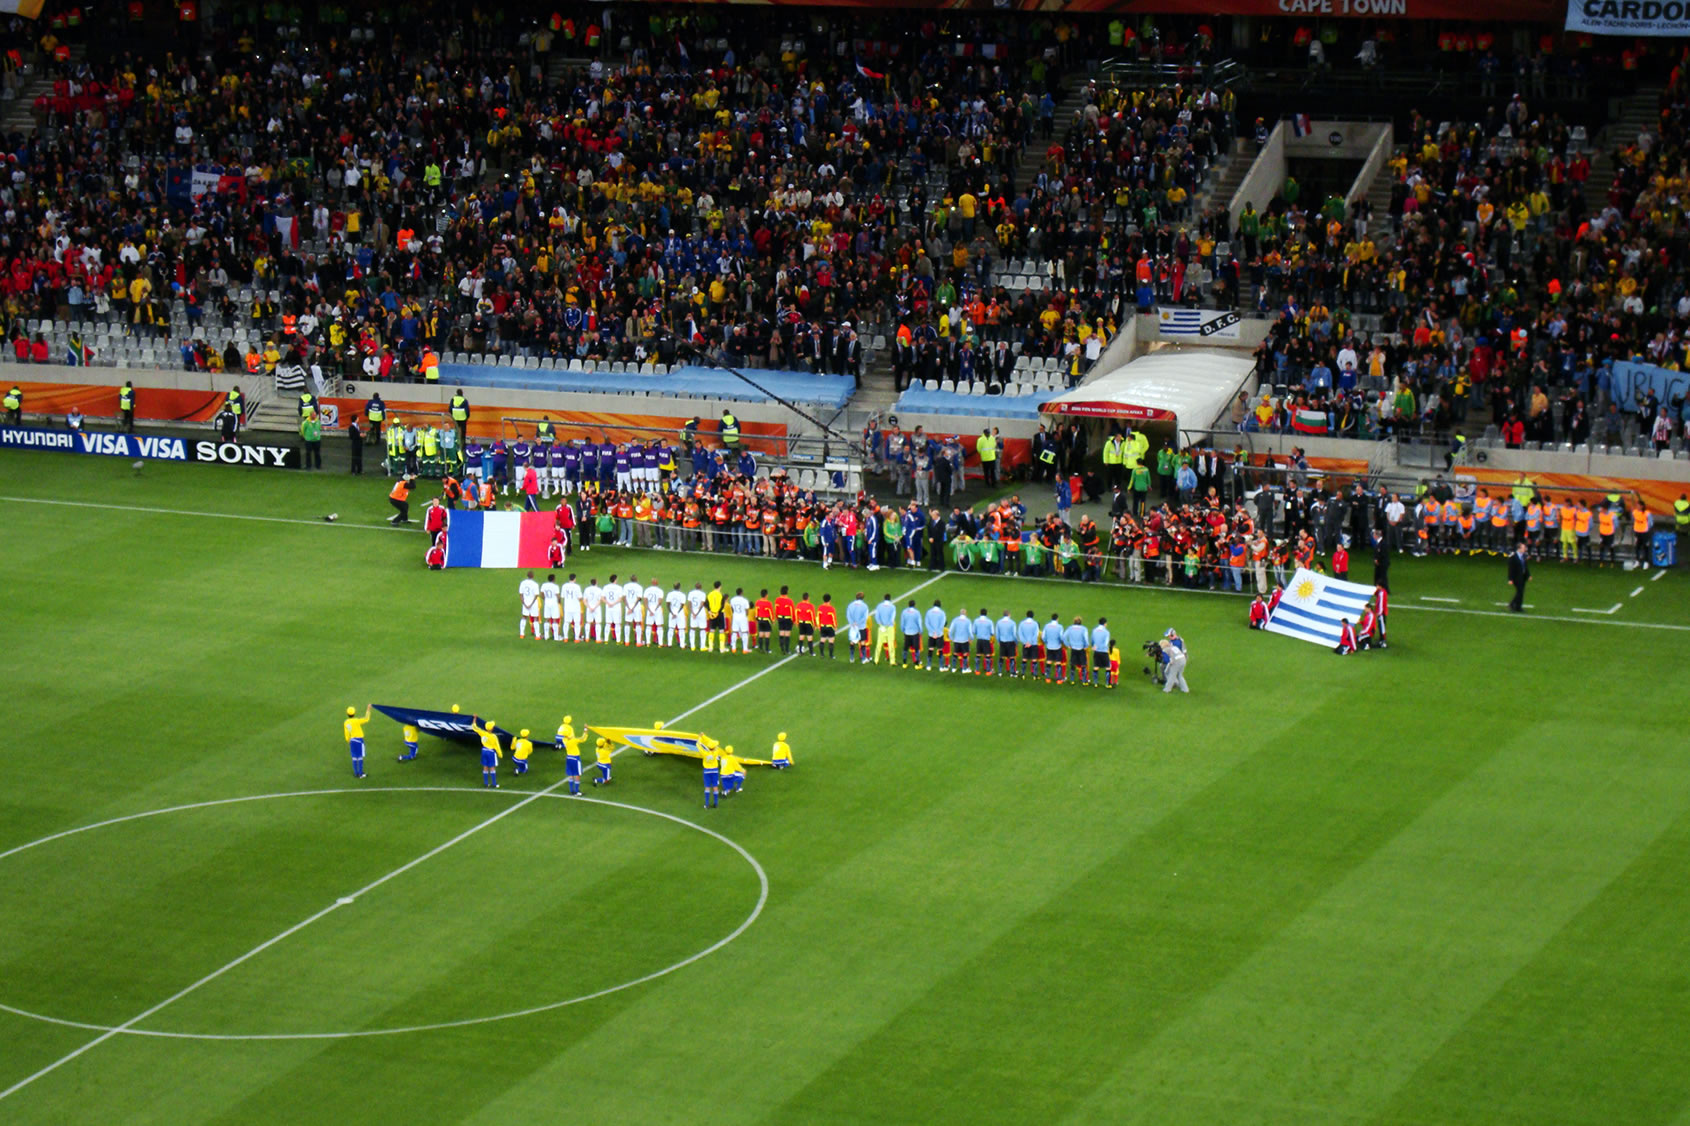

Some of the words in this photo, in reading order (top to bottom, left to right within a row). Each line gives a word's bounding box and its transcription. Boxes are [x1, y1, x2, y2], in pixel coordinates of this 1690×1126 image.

[1278, 0, 1333, 13] CAPE
[1342, 0, 1406, 14] TOWN
[2, 429, 73, 448] HYUNDAI
[79, 432, 129, 456] VISA
[134, 436, 185, 460] VISA
[196, 441, 290, 467] SONY
[608, 591, 614, 600] 8
